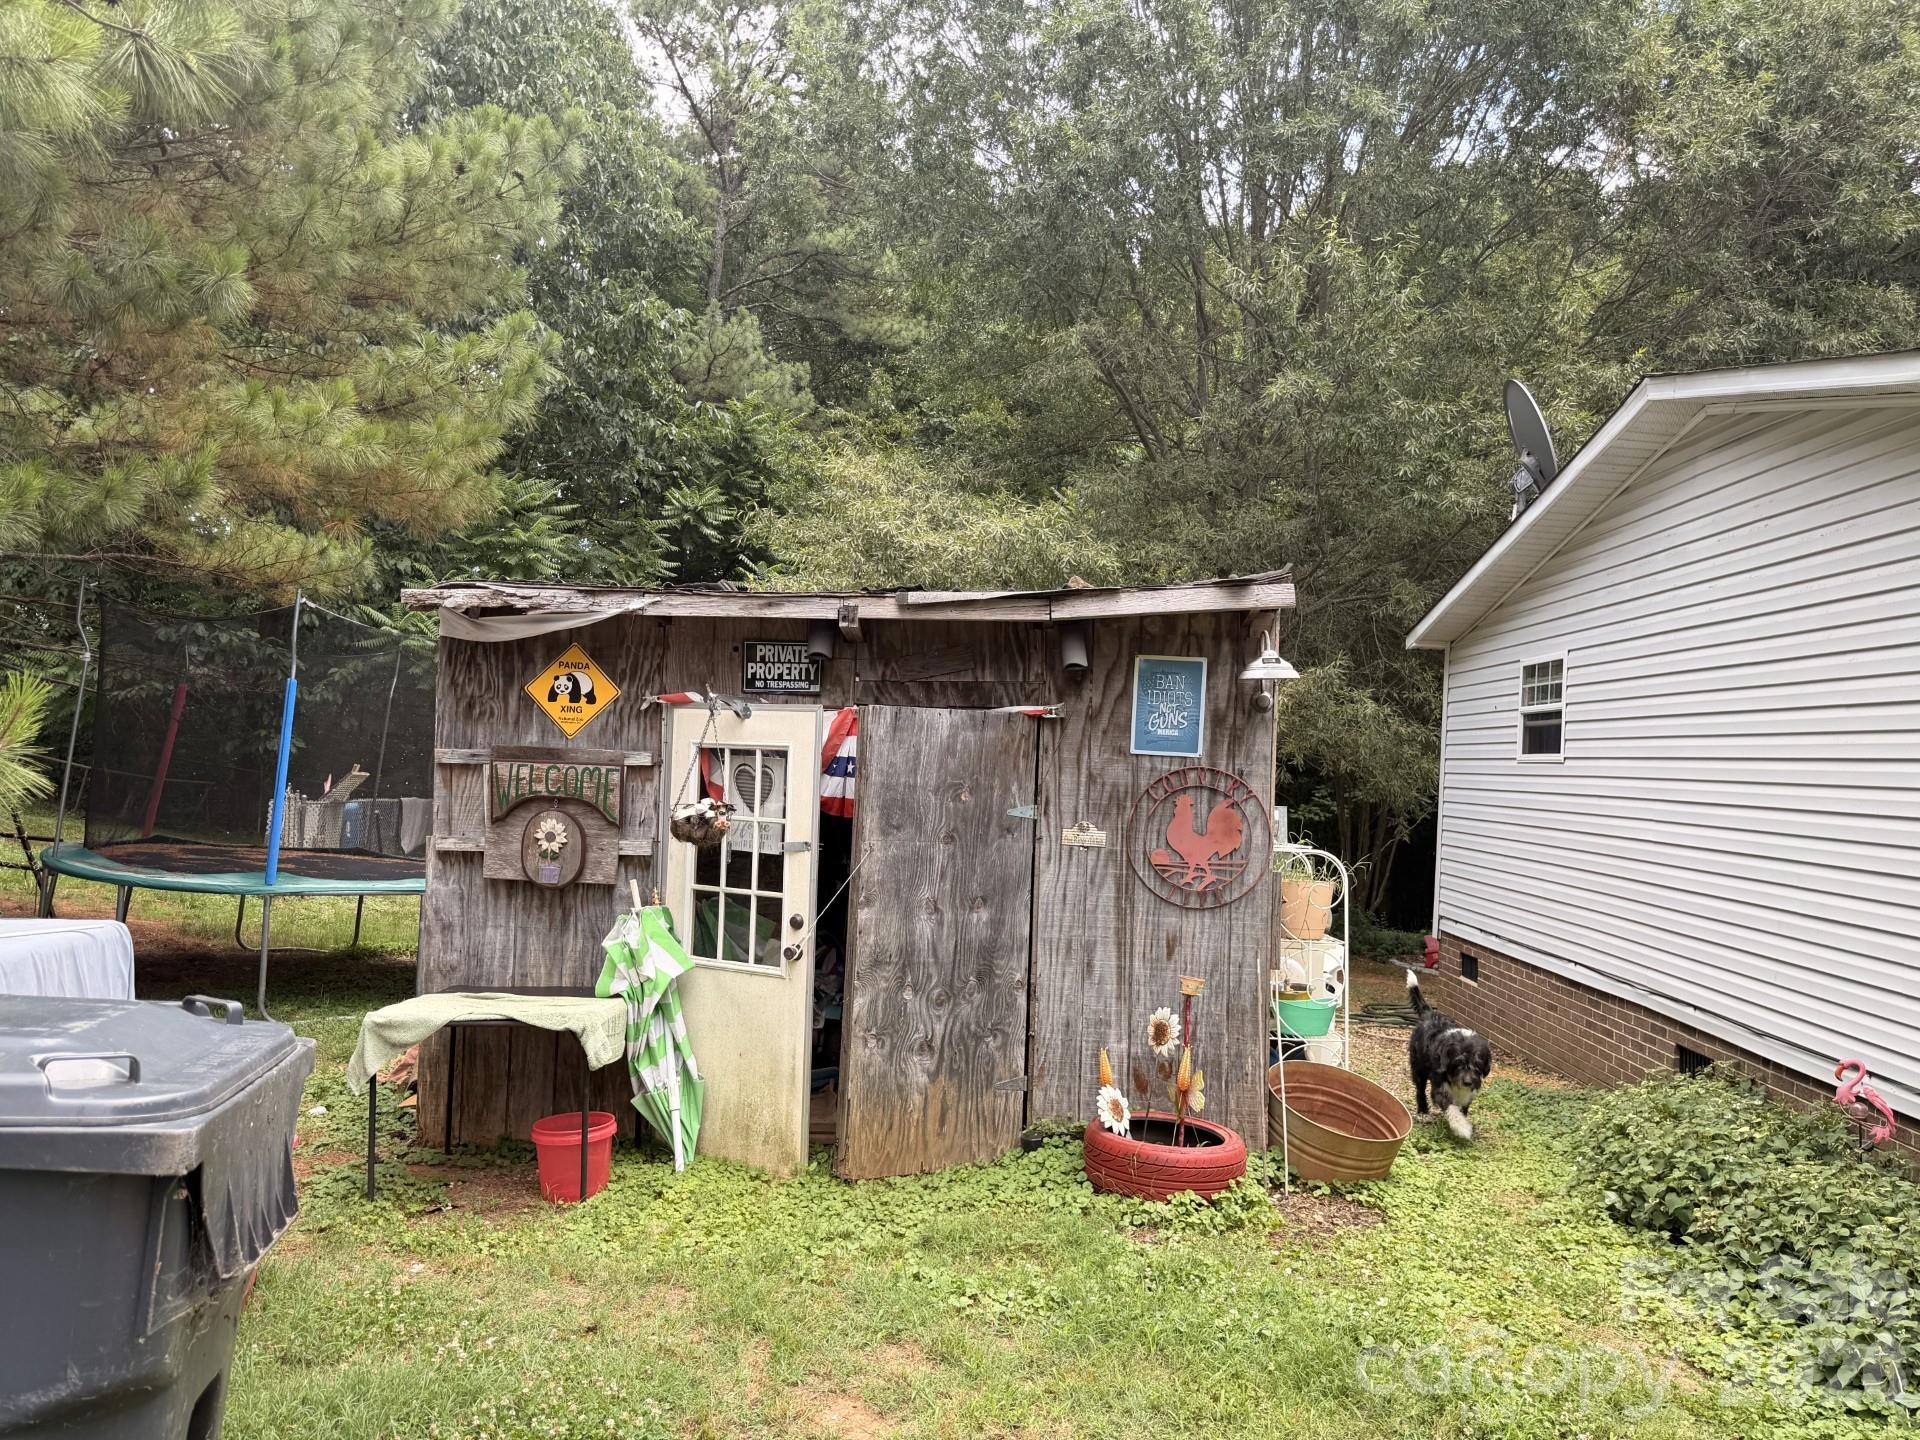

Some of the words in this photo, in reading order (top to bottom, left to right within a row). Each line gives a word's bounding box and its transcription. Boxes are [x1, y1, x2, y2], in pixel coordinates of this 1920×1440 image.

[756, 644, 810, 663] PRIVATE
[558, 661, 591, 670] PANDA
[747, 662, 818, 681] PROPERTY
[755, 680, 765, 688] NO
[766, 680, 810, 689] TRESPASSING
[1155, 674, 1186, 690] BAN
[1147, 689, 1193, 707] IDIOTS
[560, 705, 584, 714] XING
[1159, 702, 1180, 715] NOT
[1148, 710, 1188, 731] GUNS
[495, 763, 620, 822] WELCOME
[1148, 766, 1256, 804] COUNTRY
